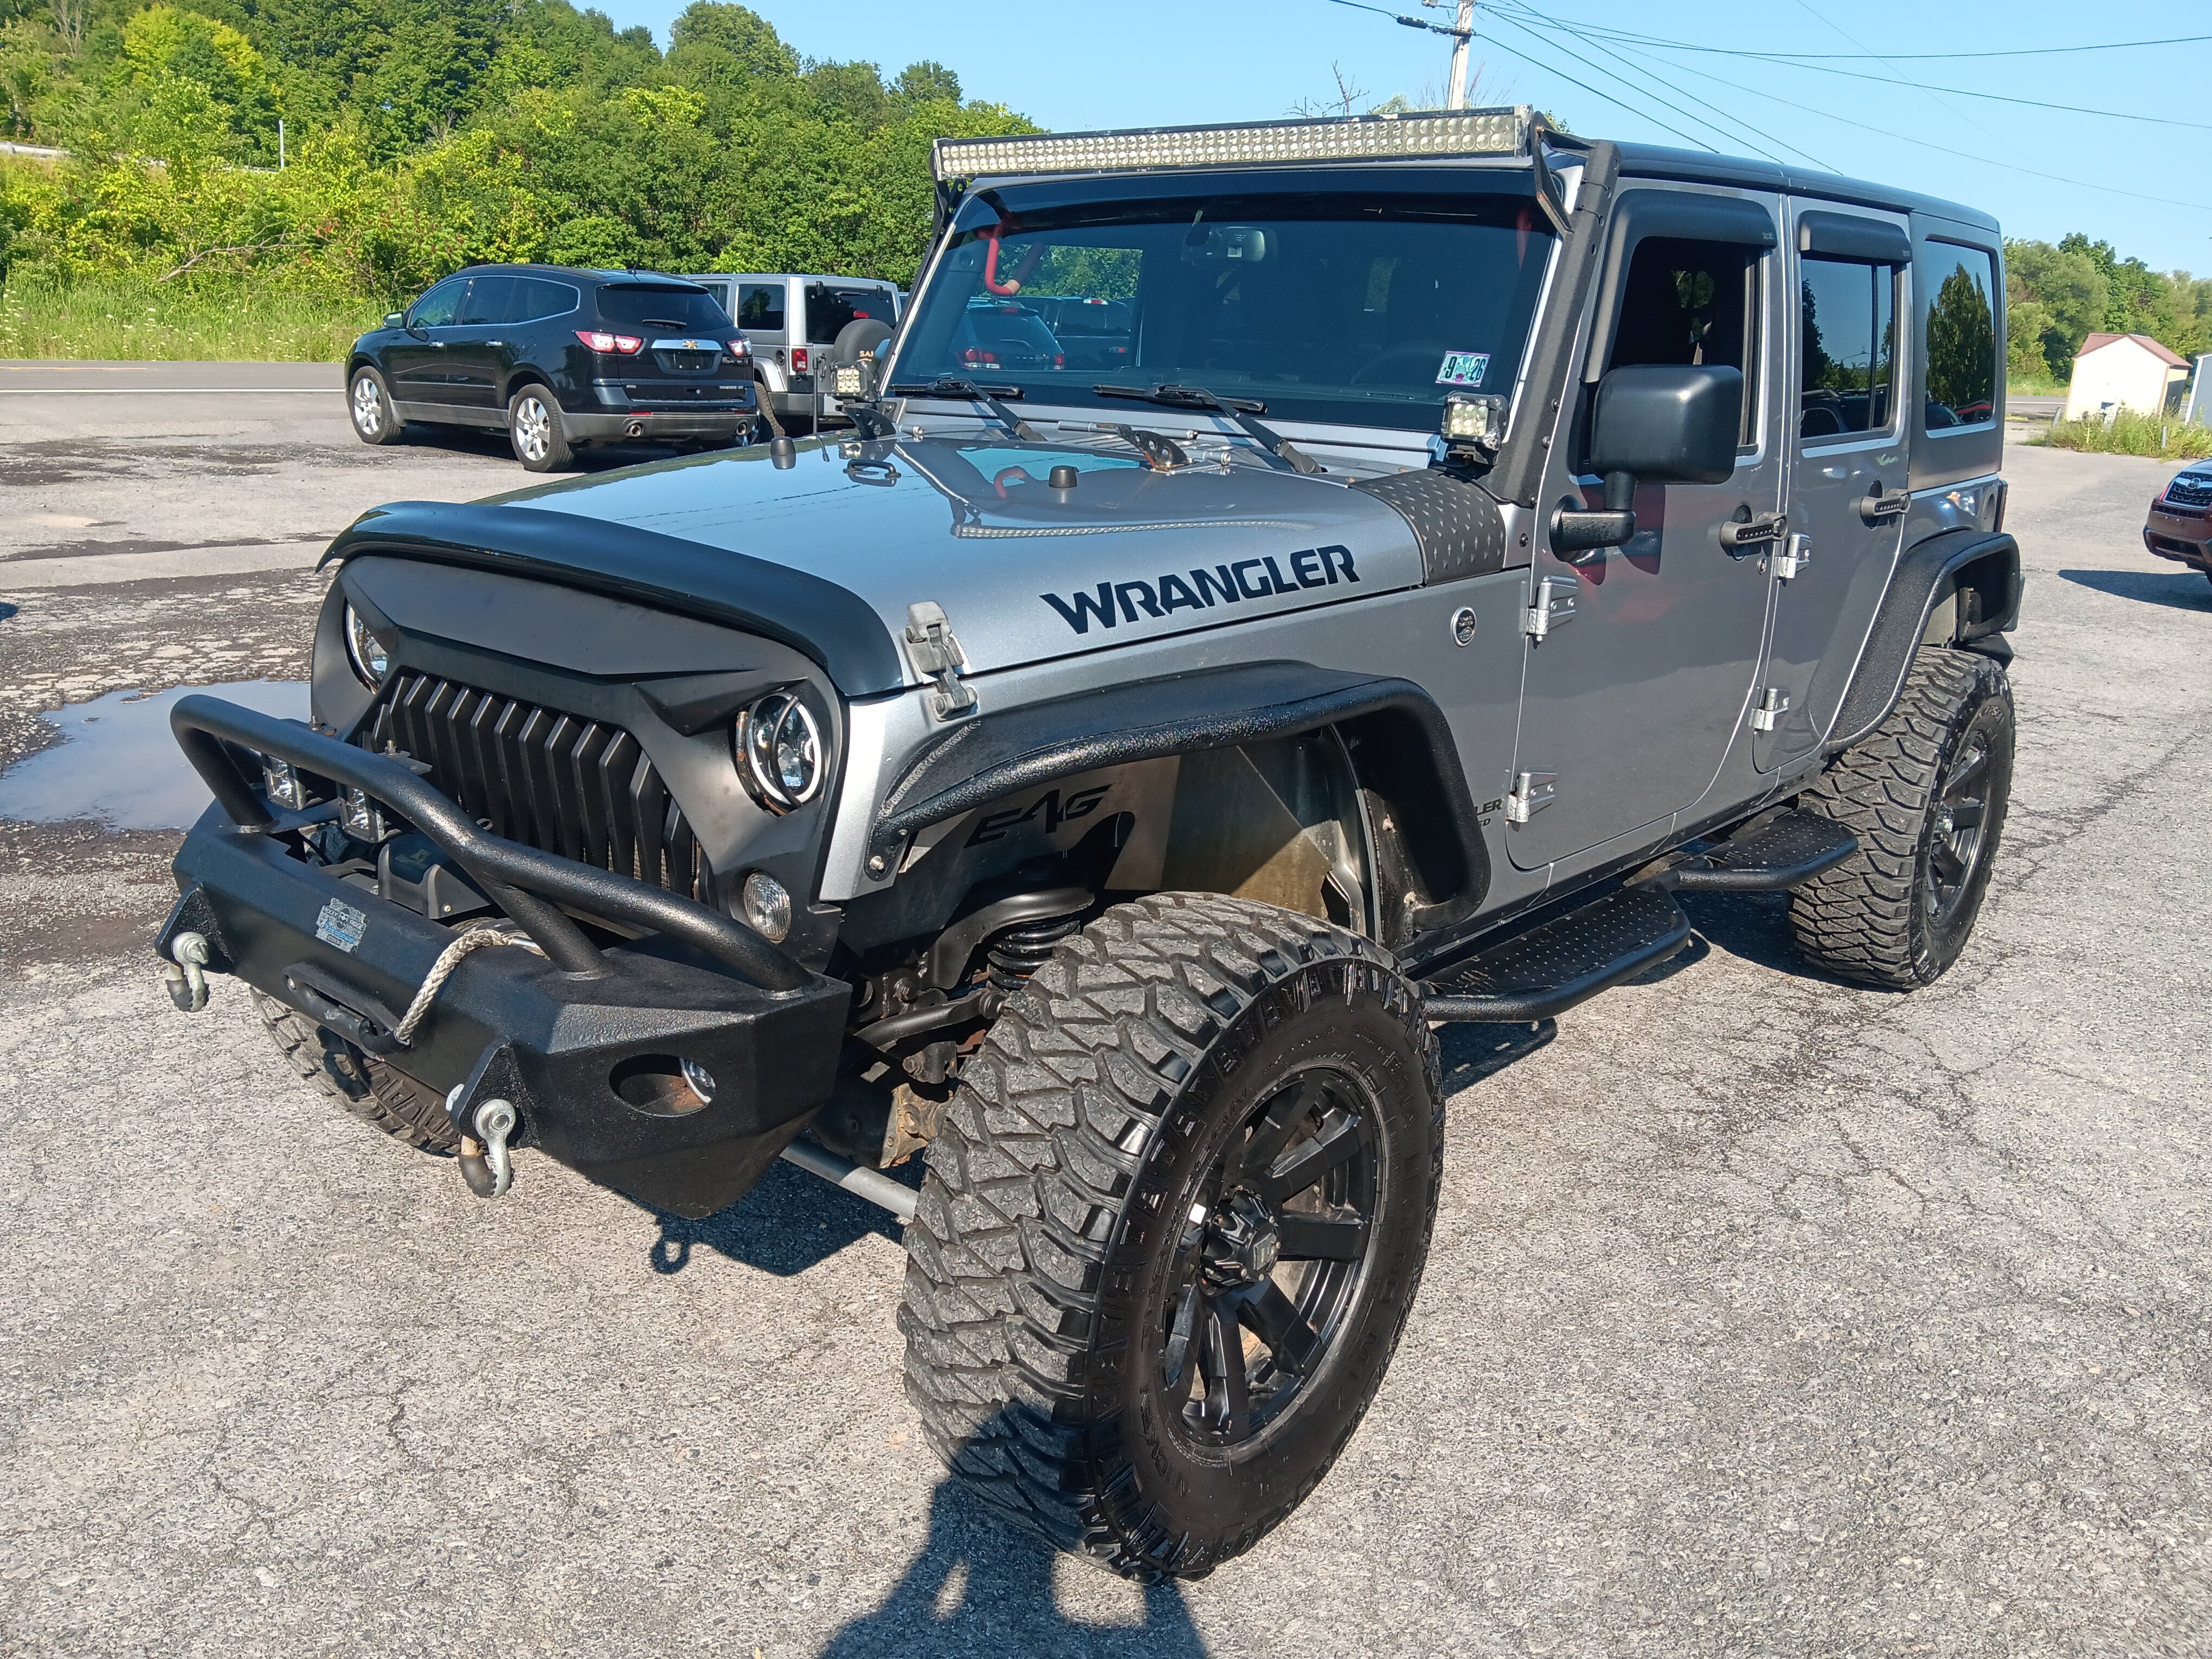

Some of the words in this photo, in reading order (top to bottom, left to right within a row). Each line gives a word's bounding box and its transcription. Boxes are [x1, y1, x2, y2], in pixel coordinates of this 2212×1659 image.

[1444, 356, 1458, 379] 9
[1469, 358, 1487, 381] 26
[1039, 544, 1361, 635] WRANGLER
[962, 782, 1115, 849] EAG
